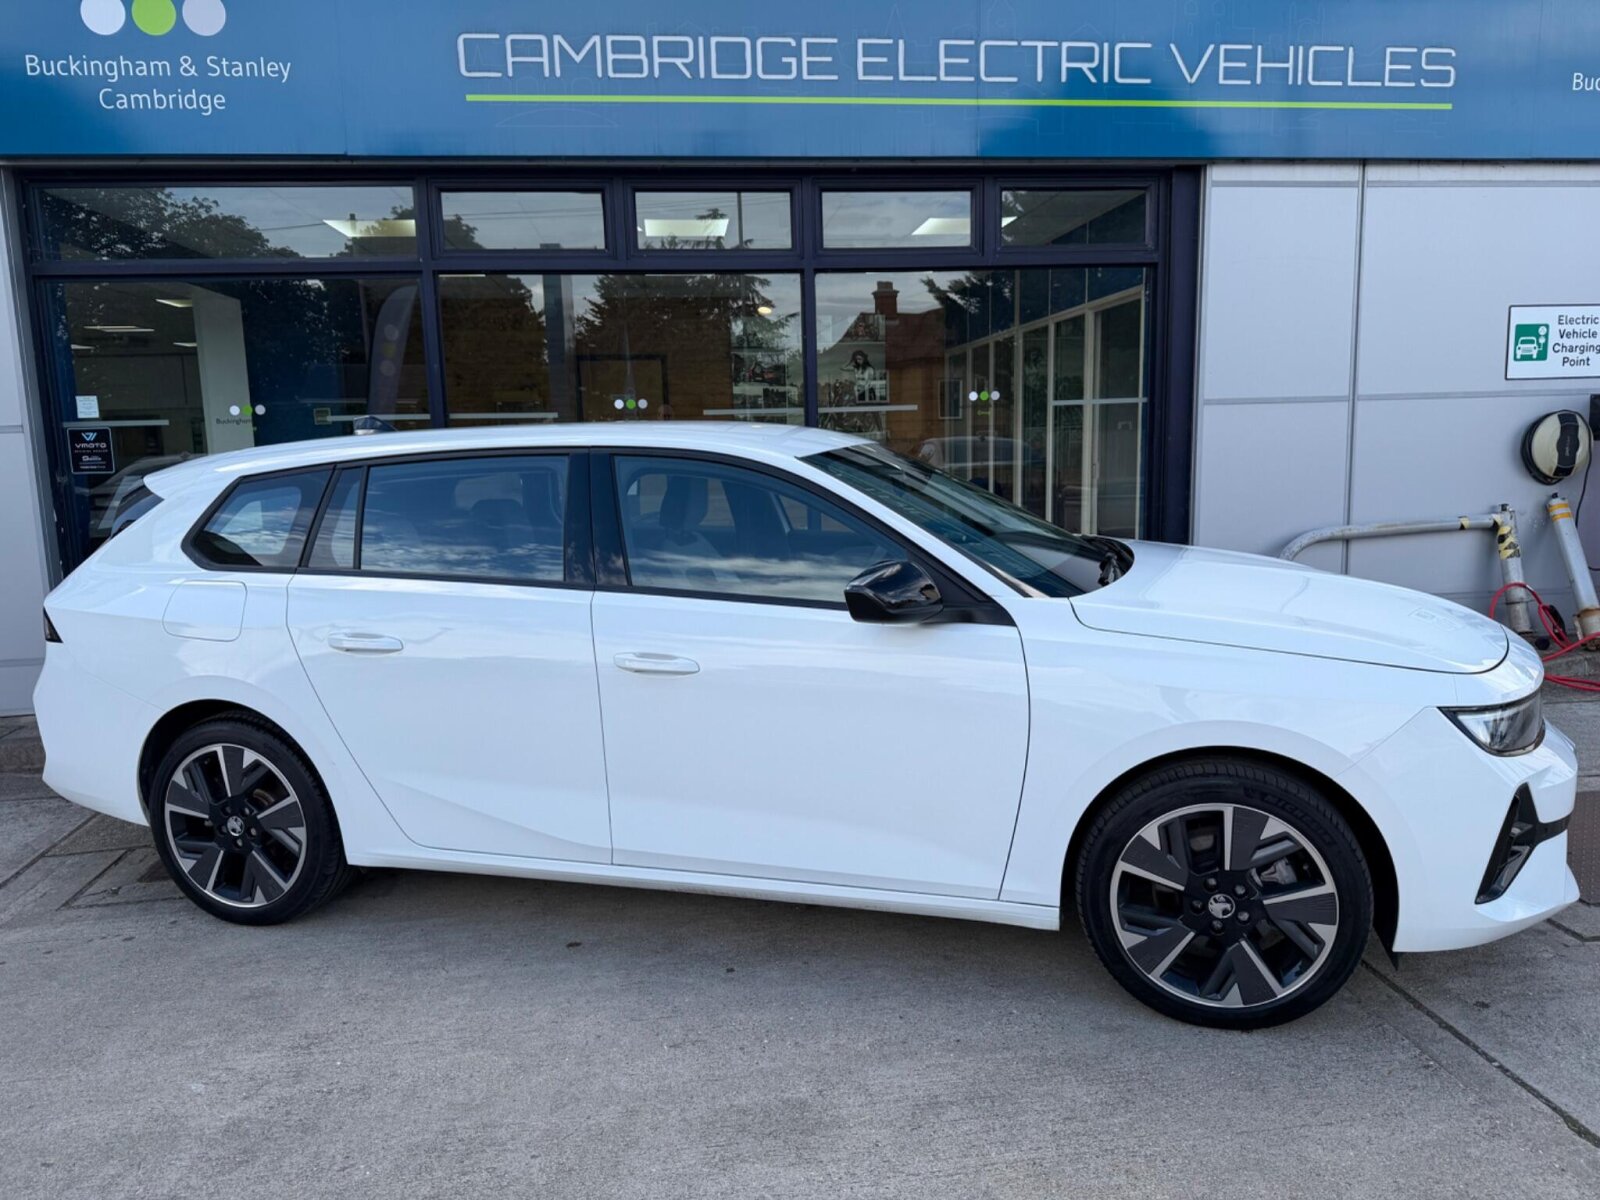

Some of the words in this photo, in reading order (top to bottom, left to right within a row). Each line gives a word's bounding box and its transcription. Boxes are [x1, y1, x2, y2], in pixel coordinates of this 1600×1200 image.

[456, 33, 839, 80] CAMBRIDGE
[856, 38, 1153, 85] ELECTRIC
[1169, 43, 1456, 88] VEHICLES
[24, 54, 171, 83] Buckingham
[179, 55, 199, 77] &
[206, 56, 292, 83] Stanley
[98, 88, 226, 115] Cambridge
[1557, 314, 1600, 326] Electric
[1558, 328, 1598, 340] Vehicle
[1552, 342, 1600, 355] Charging
[1561, 356, 1591, 367] Point
